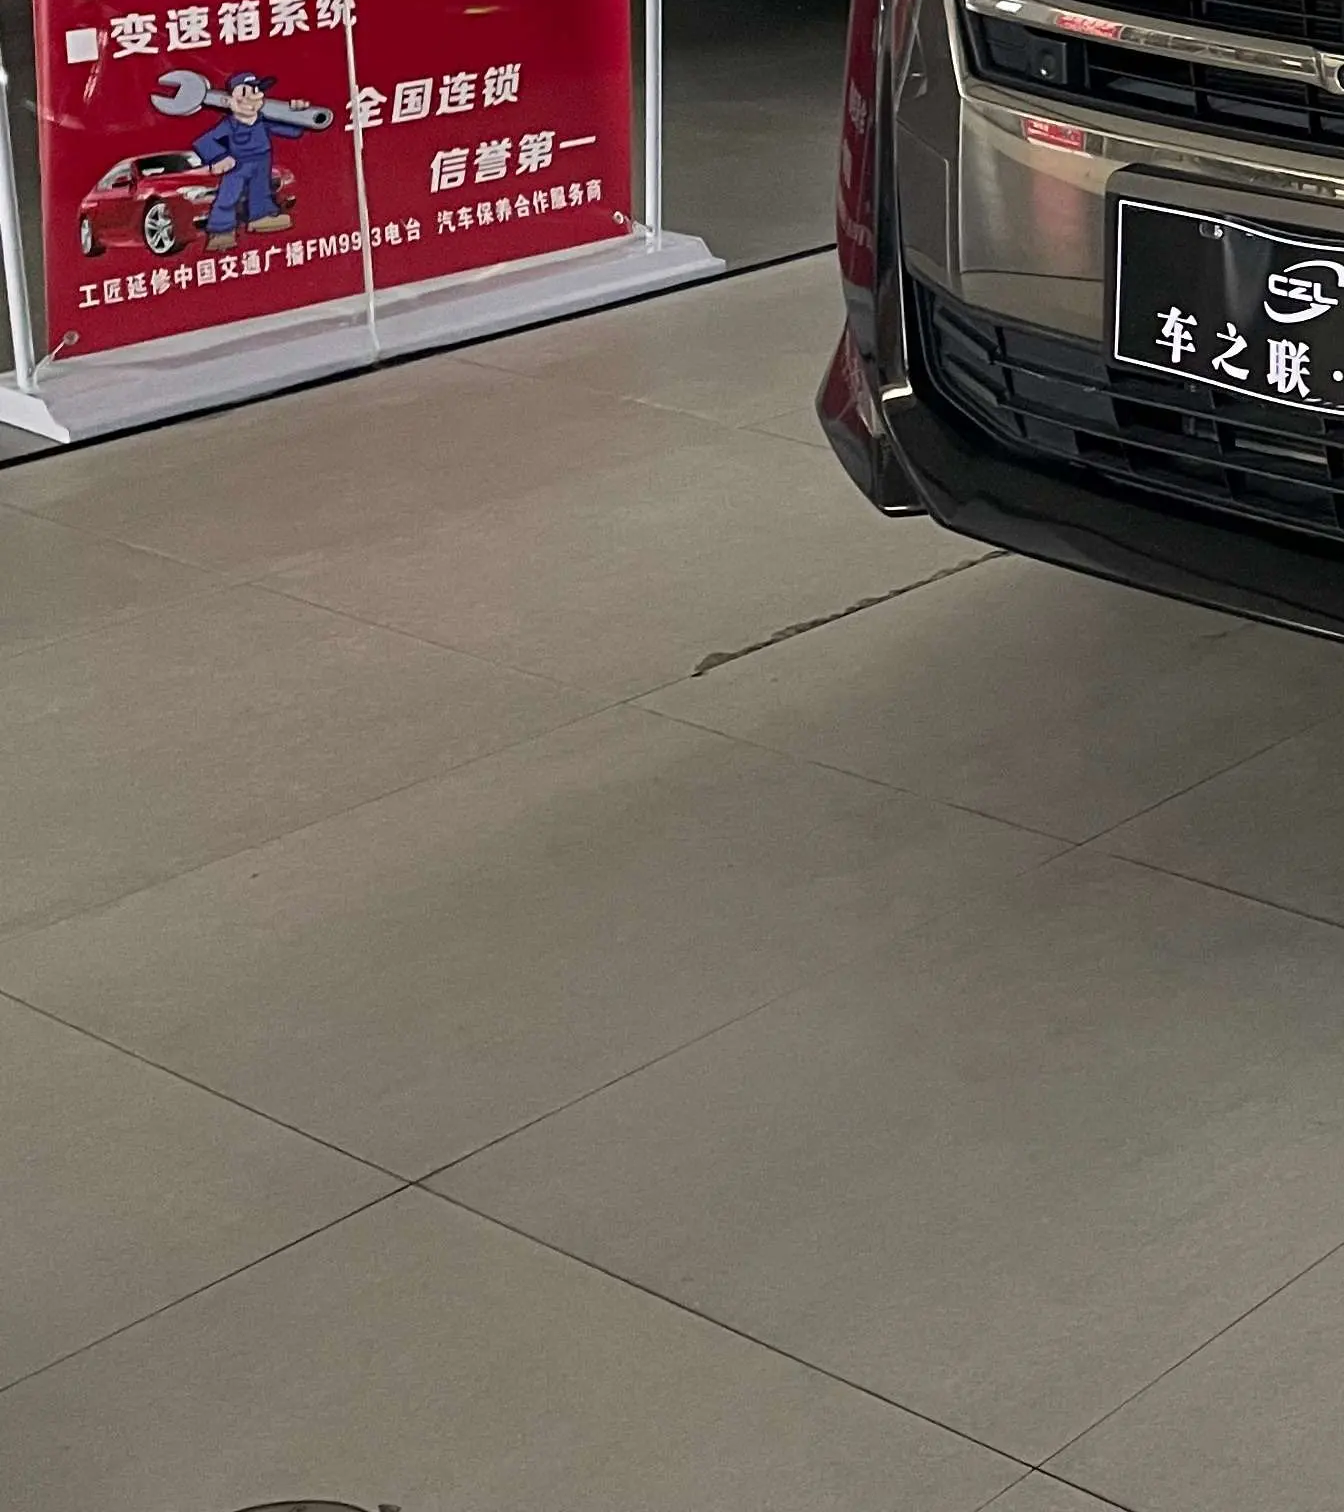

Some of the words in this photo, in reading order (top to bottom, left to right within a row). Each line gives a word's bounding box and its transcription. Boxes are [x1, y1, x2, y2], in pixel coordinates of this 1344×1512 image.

[345, 63, 523, 133] 全国连锁
[429, 129, 597, 193] 信誉第一
[78, 218, 421, 309] 工匠延修中国交通广播FM993电台
[437, 179, 602, 235] 汽车保养合作服务商
[1268, 273, 1338, 307] CZL
